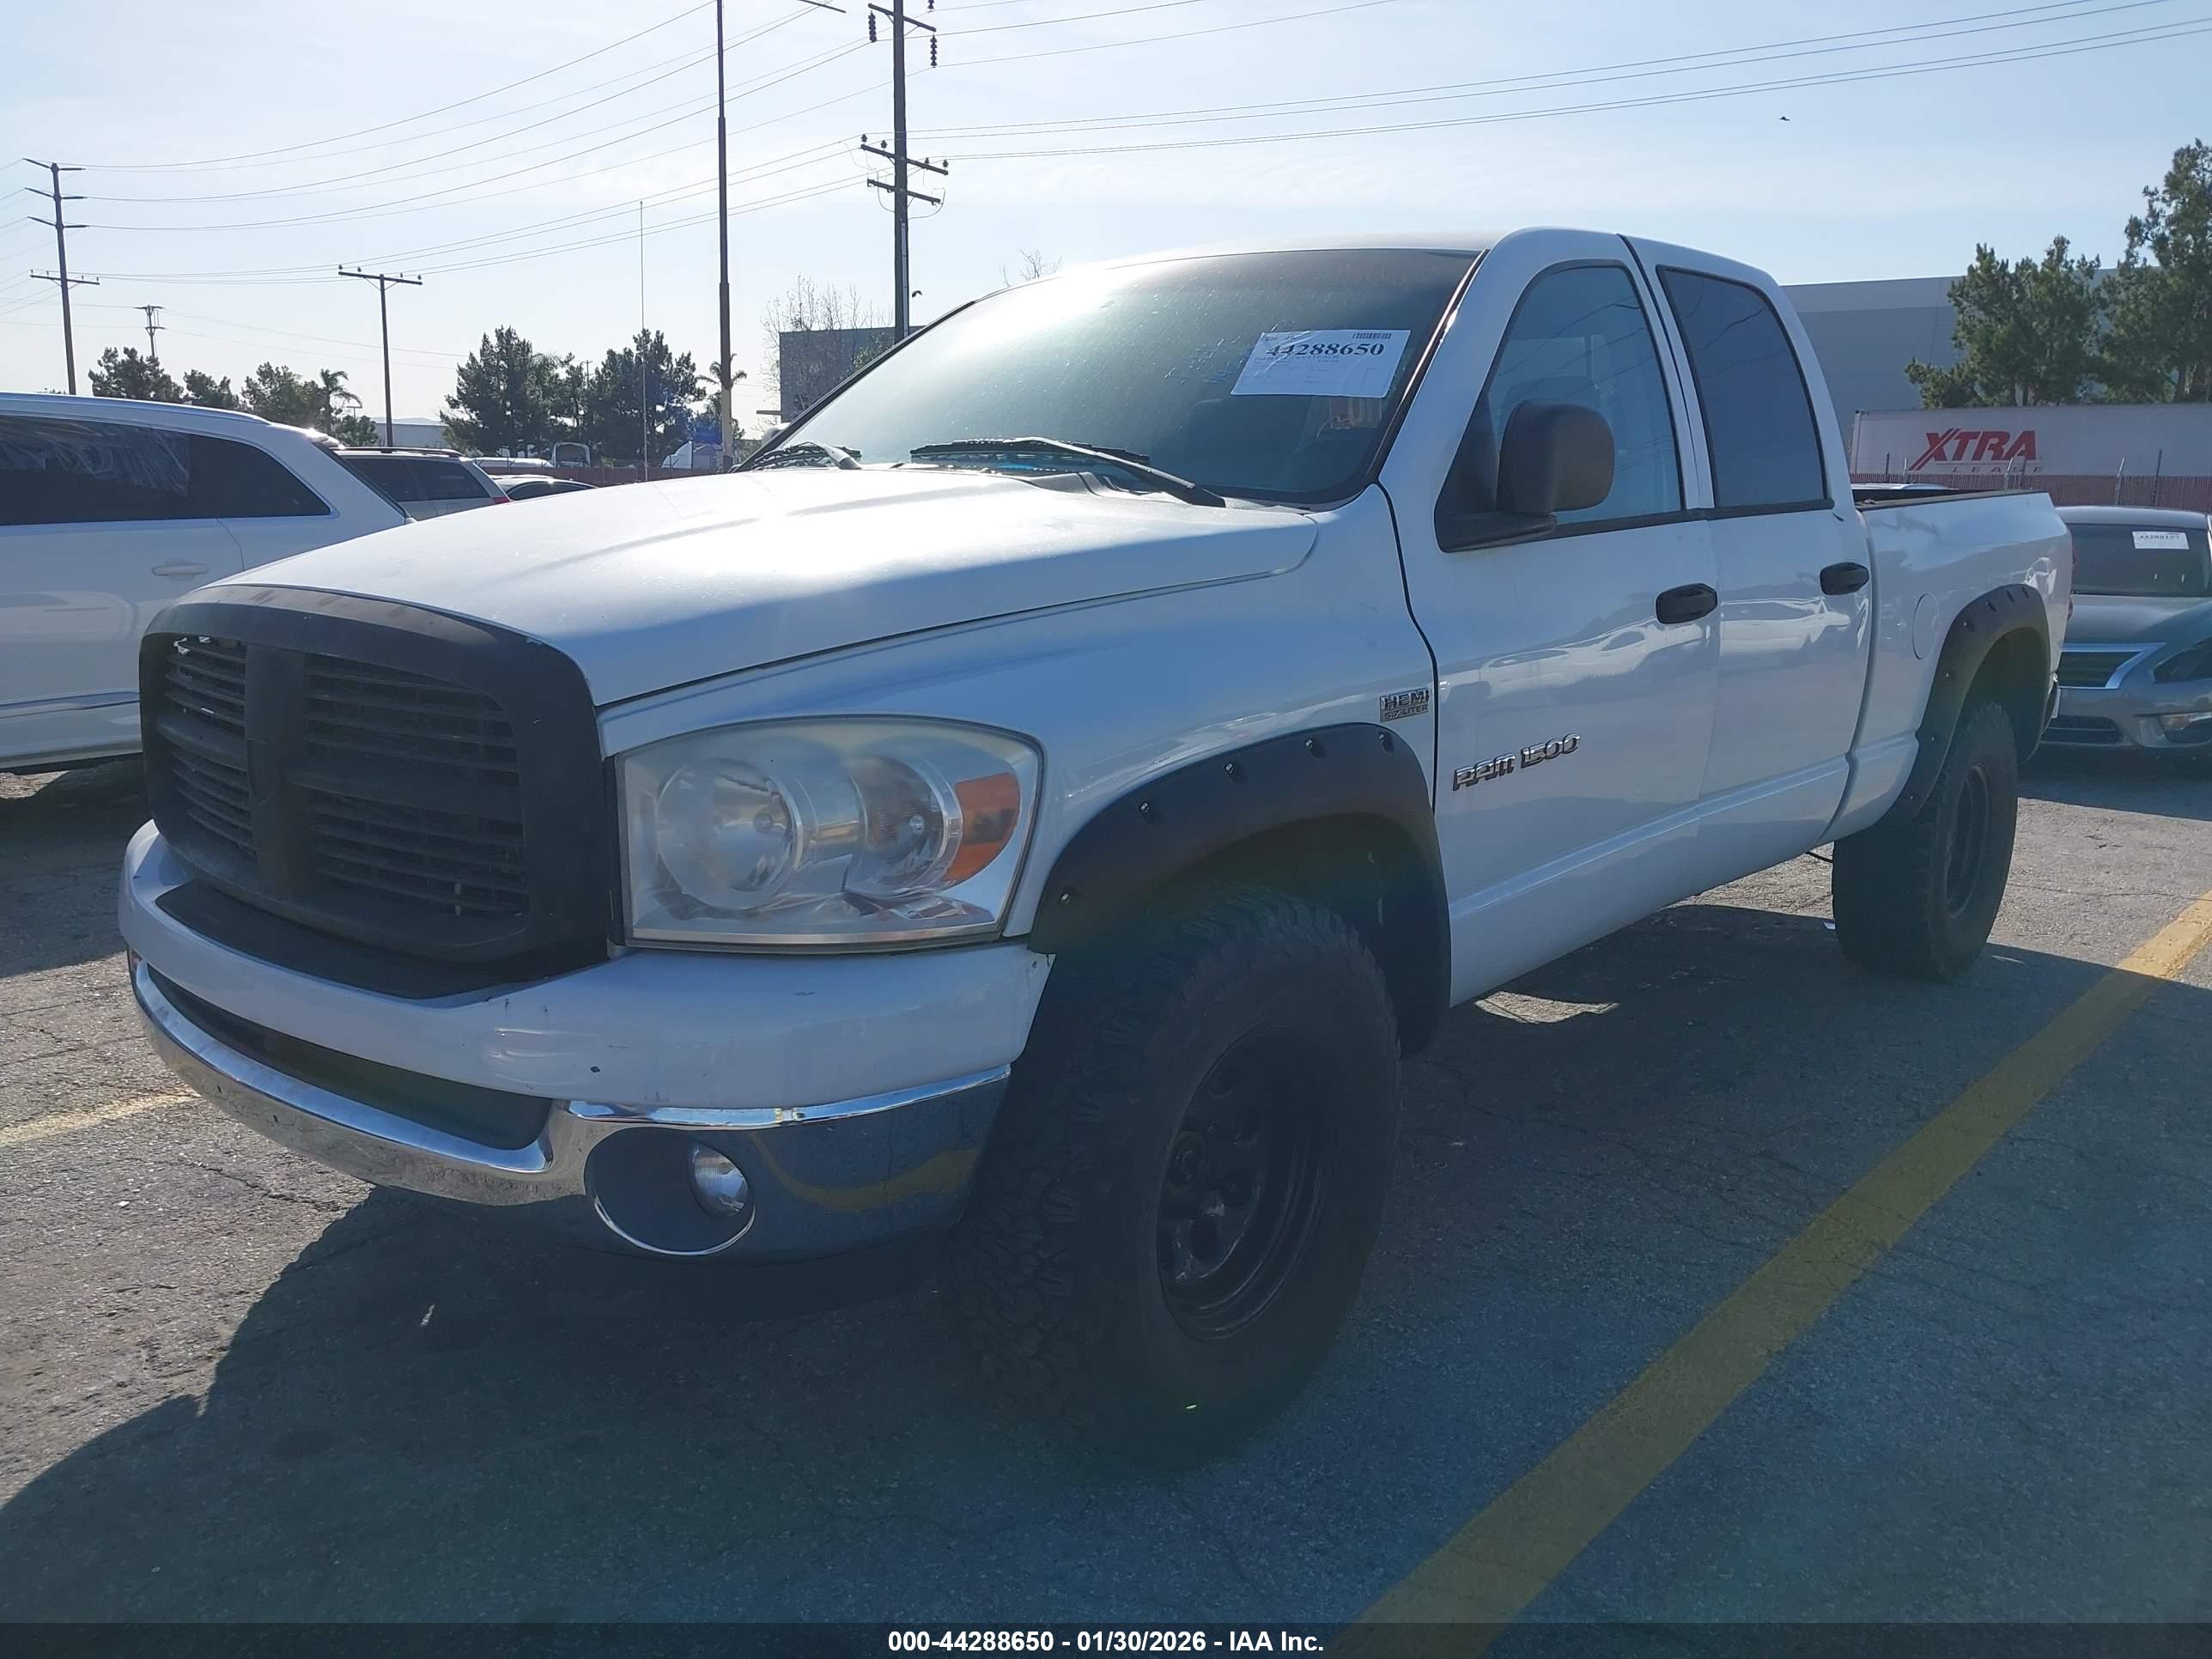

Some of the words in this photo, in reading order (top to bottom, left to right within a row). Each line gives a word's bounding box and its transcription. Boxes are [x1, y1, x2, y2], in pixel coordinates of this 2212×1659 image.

[1266, 343, 1384, 356] 44288650
[1909, 428, 2037, 471] XTRA
[1382, 690, 1430, 710] HEMI
[1521, 732, 1580, 769] 1500
